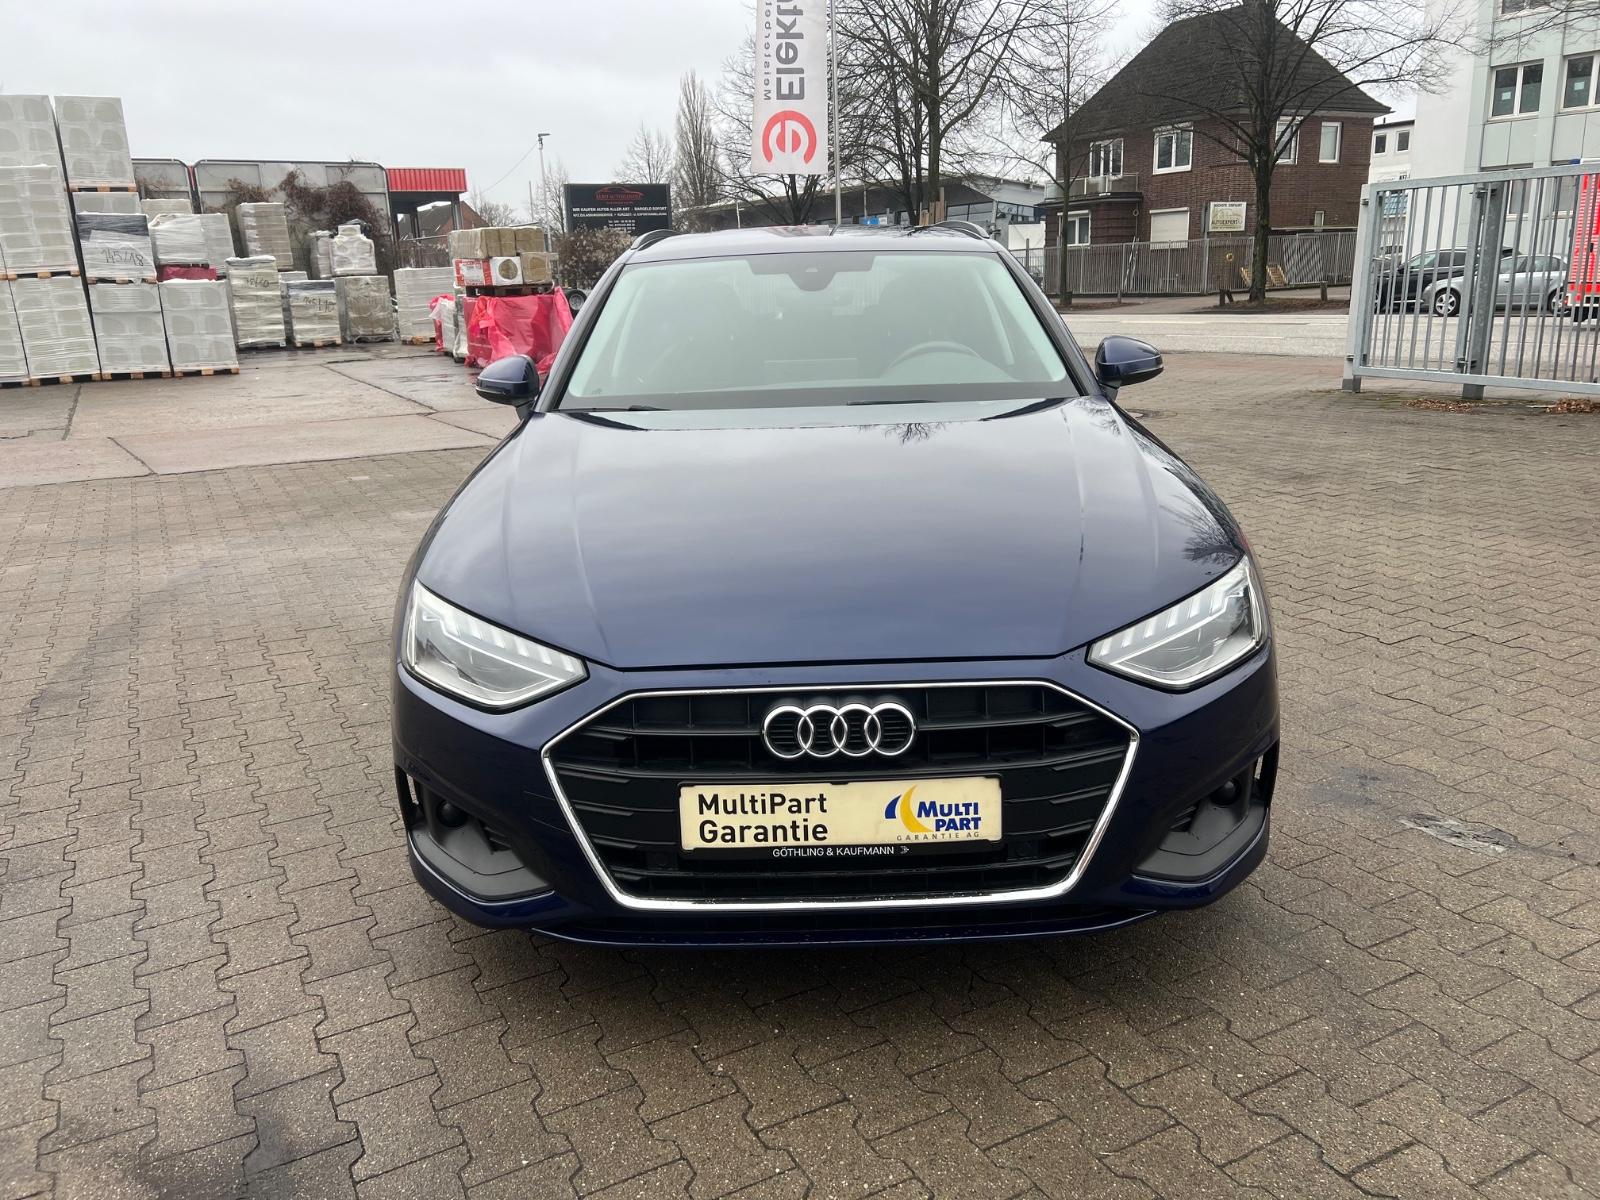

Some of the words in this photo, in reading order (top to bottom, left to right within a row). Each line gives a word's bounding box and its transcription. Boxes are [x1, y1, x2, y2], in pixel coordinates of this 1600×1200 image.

[698, 793, 828, 815] MultiPart
[917, 801, 979, 818] MULTI
[699, 818, 828, 843] Garantie
[935, 817, 982, 832] PART
[896, 832, 960, 841] GARANTIE
[772, 847, 824, 857] GÖTHLING
[826, 847, 834, 856] &
[836, 846, 895, 856] KAUFMANN
